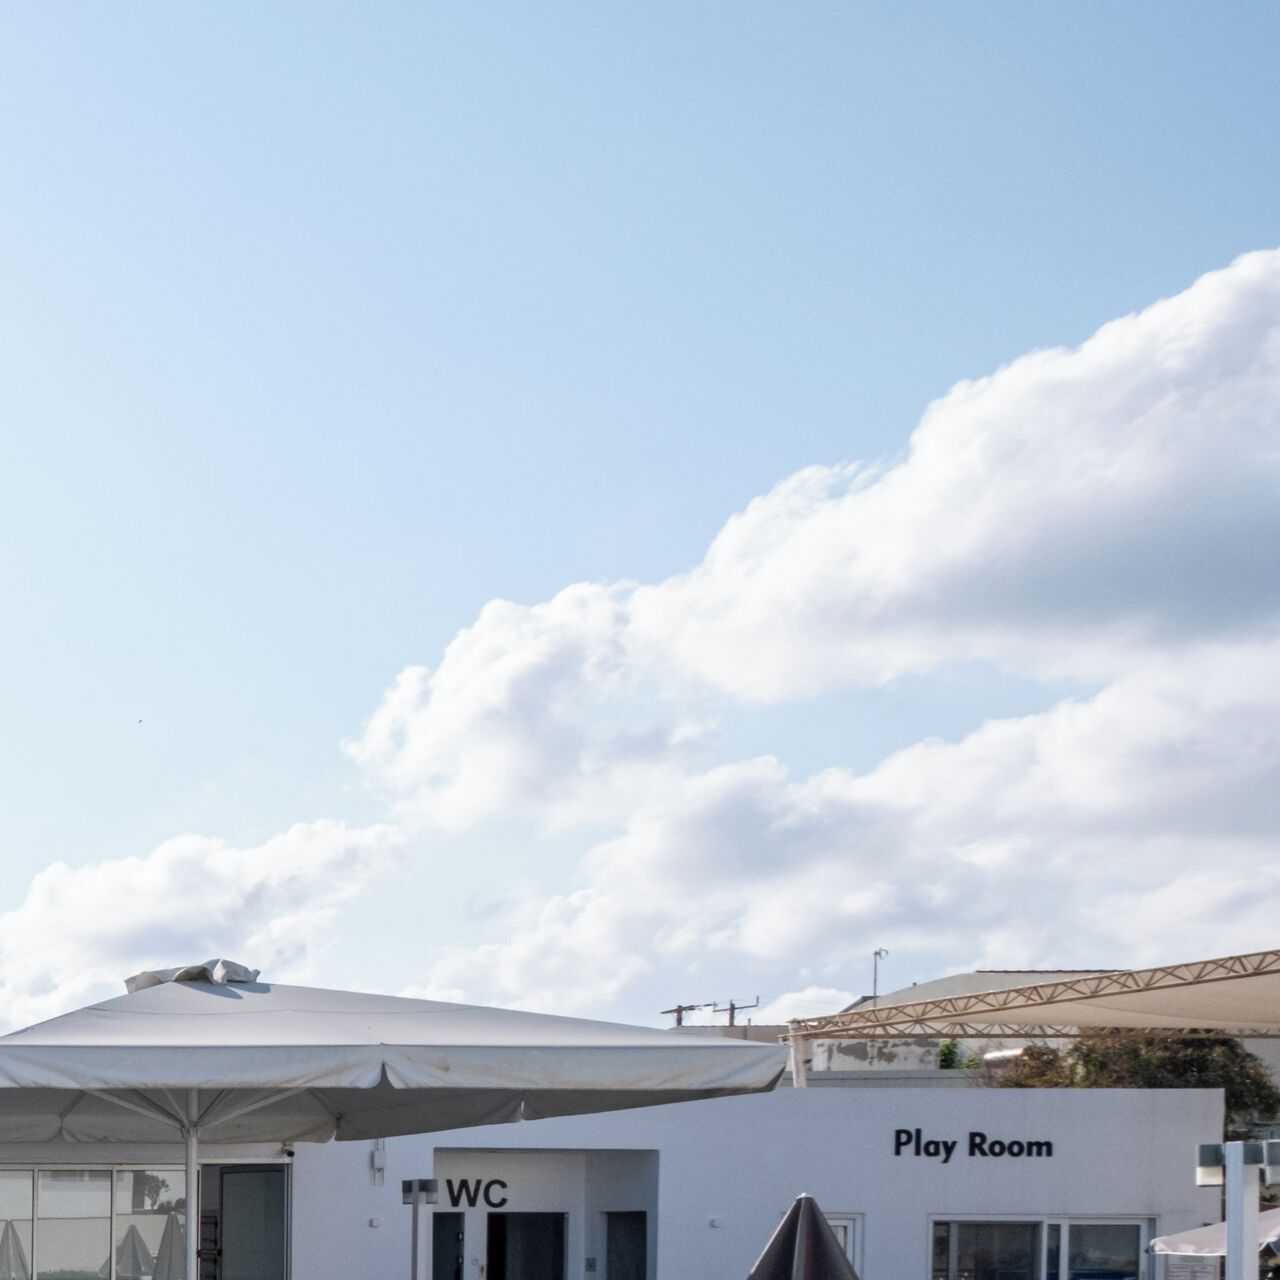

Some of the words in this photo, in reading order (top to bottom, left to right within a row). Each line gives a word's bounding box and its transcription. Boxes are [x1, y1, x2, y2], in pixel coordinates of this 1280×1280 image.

[894, 1128, 957, 1164] Play
[968, 1131, 1053, 1157] Room
[446, 1178, 508, 1208] WC
